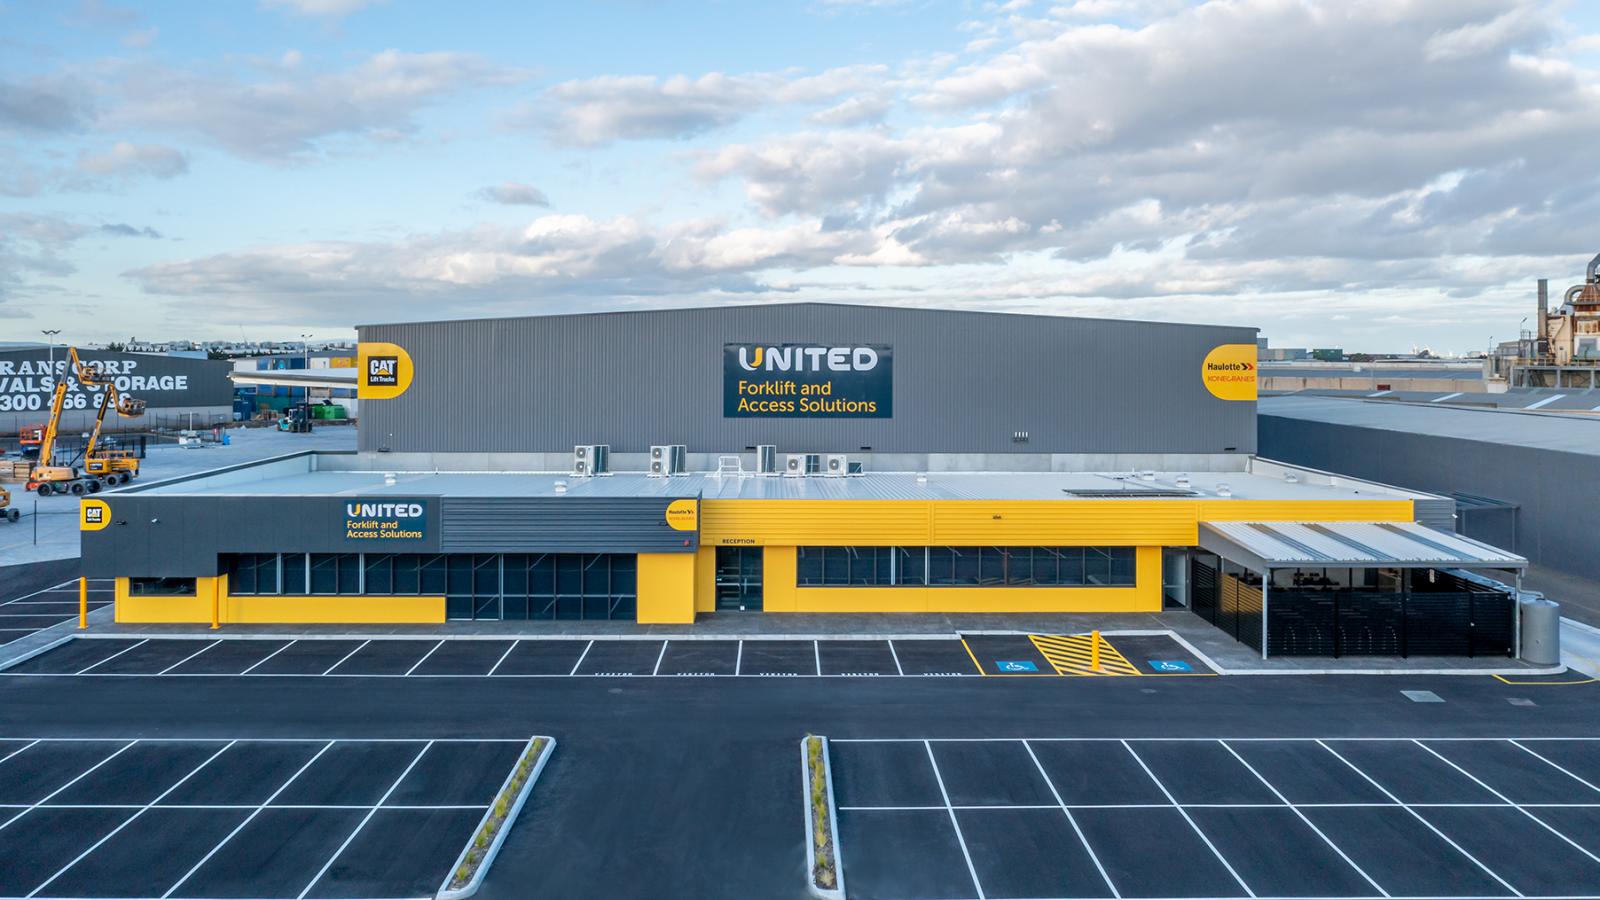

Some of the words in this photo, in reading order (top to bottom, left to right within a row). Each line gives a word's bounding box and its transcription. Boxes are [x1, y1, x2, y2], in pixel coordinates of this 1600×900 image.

[738, 346, 878, 371] UNITED
[370, 359, 395, 375] CAT
[1207, 362, 1241, 371] Haulotte
[67, 376, 80, 392] &
[86, 375, 188, 392] ORAGE
[738, 380, 796, 395] Forklift
[800, 381, 831, 395] and
[737, 398, 795, 412] Access
[799, 398, 877, 412] Solutions
[87, 508, 102, 517] CAT
[347, 503, 423, 517] UNITED
[346, 520, 379, 529] Forklift
[380, 521, 398, 529] and
[346, 529, 378, 538] Access
[379, 529, 422, 538] Solutions
